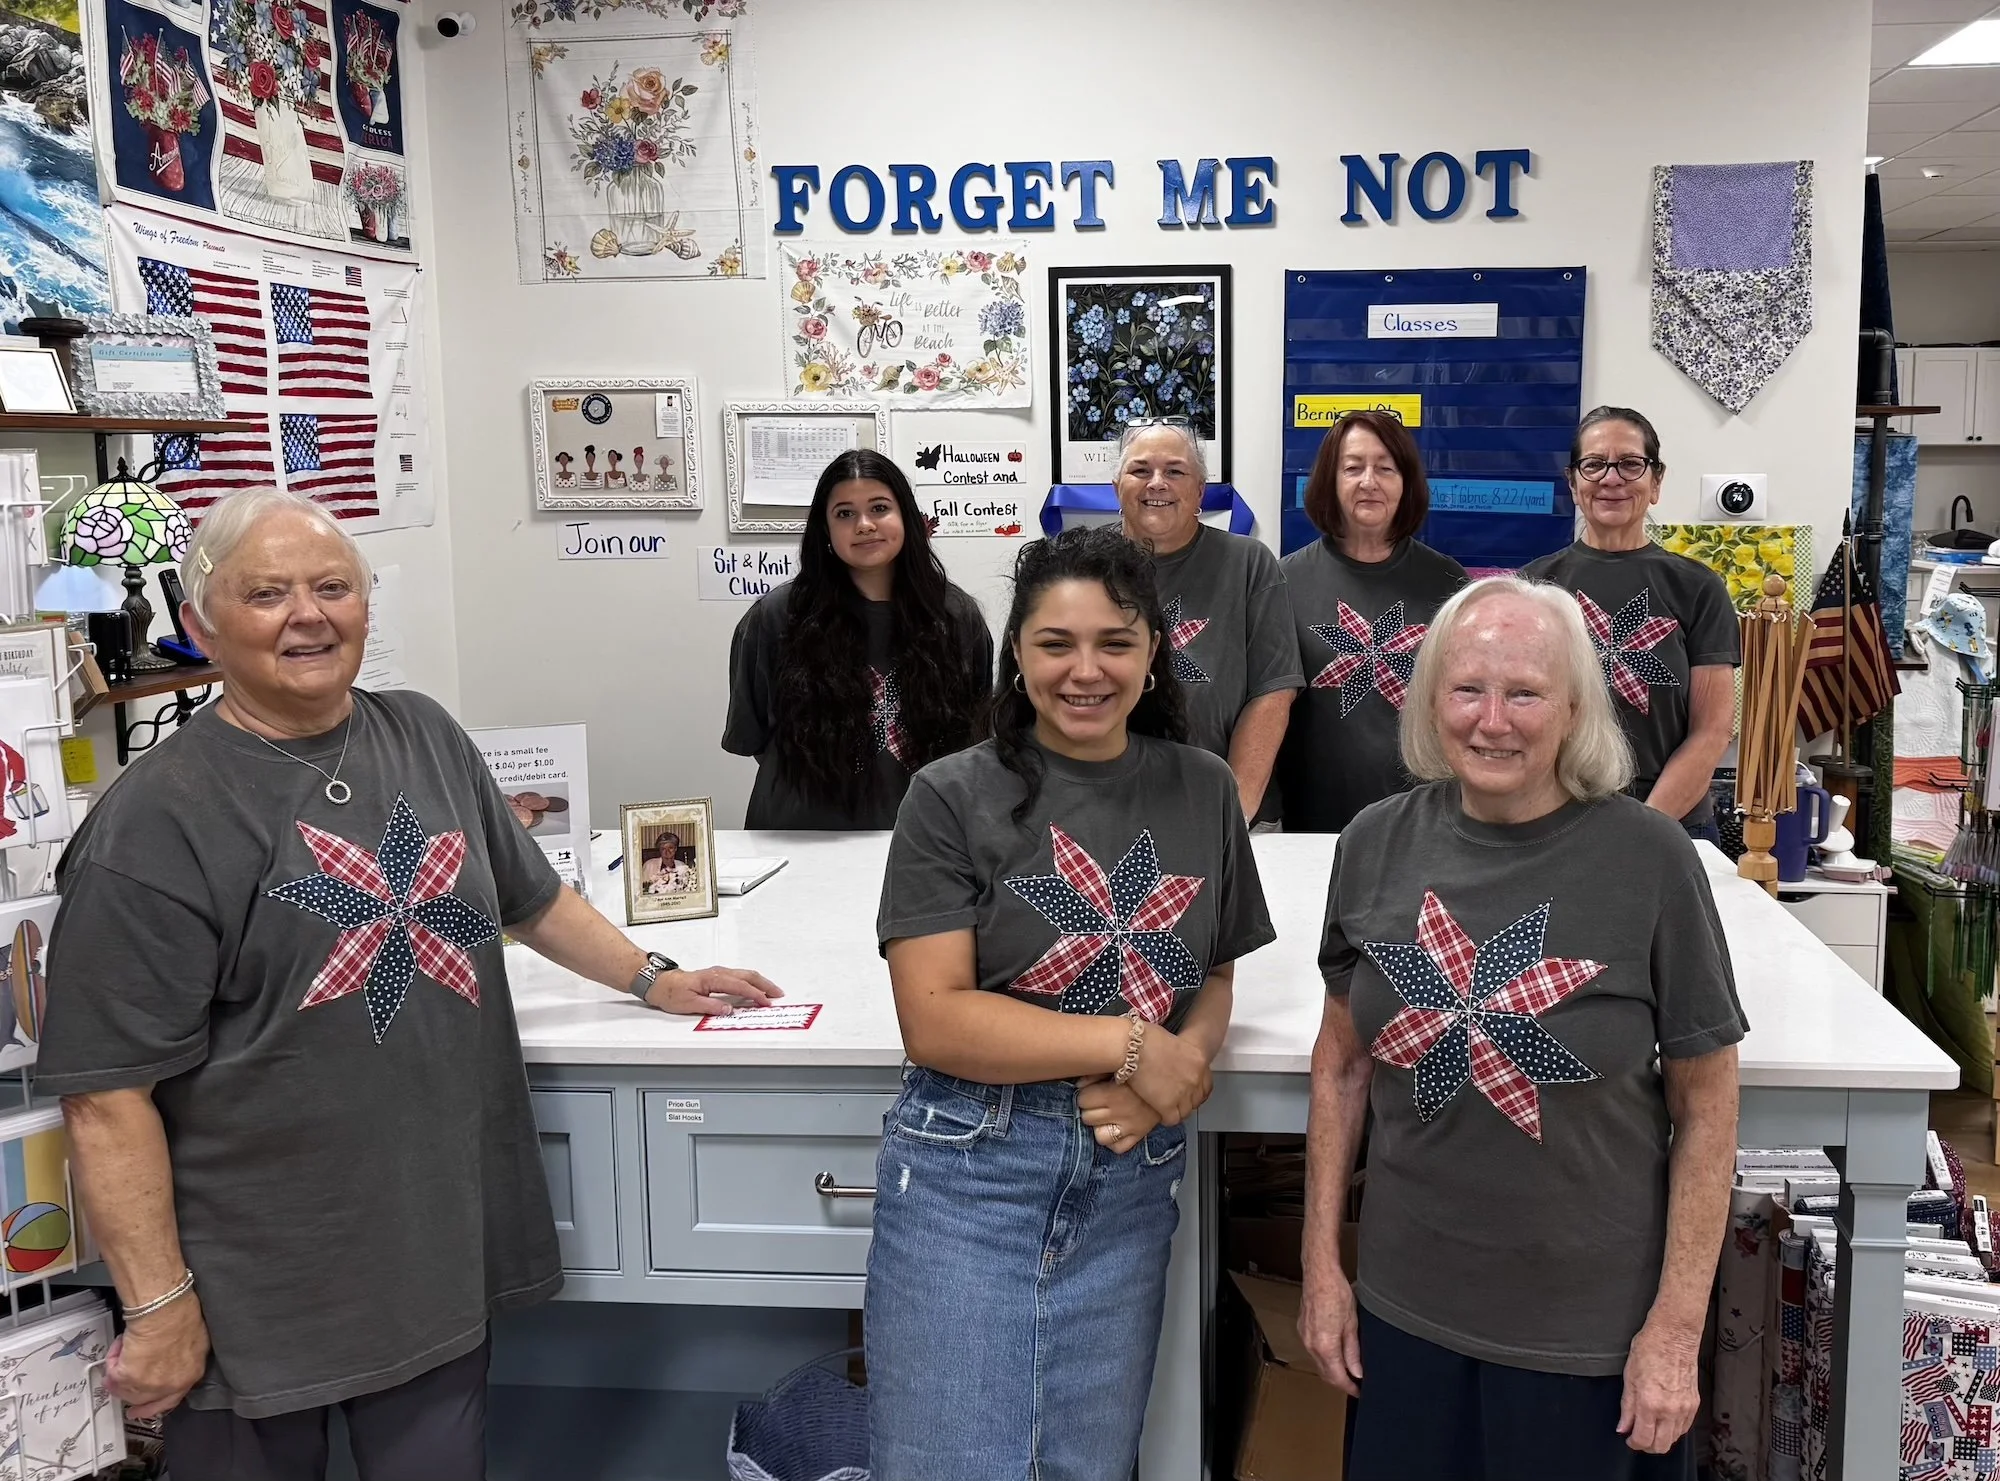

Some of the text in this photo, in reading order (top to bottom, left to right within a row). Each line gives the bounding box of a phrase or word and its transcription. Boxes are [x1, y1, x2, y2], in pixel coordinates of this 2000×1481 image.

[770, 149, 1531, 234] FORGET ME NOT
[133, 222, 157, 240] Wings
[160, 229, 167, 243] of
[170, 231, 199, 247] Freedom
[889, 291, 913, 318] Life
[924, 300, 964, 318] Better
[1383, 312, 1458, 332] Classes
[914, 332, 954, 349] Beach
[98, 349, 163, 357] Gift Certificate
[943, 470, 1018, 484] Contest and
[934, 499, 1018, 517] Fall Contest
[565, 522, 666, 555] Join our
[713, 548, 792, 576] Sit & Knit
[729, 577, 770, 595] Club
[494, 749, 502, 757] is
[511, 747, 534, 756] small
[536, 746, 549, 755] fee
[495, 761, 515, 771] $.04)
[518, 761, 532, 770] per
[534, 758, 555, 768] $1.00
[499, 770, 569, 784] credit/debit card.
[668, 1113, 681, 1121] Slat
[19, 1378, 87, 1411] Thinking
[34, 1397, 80, 1424] of you
